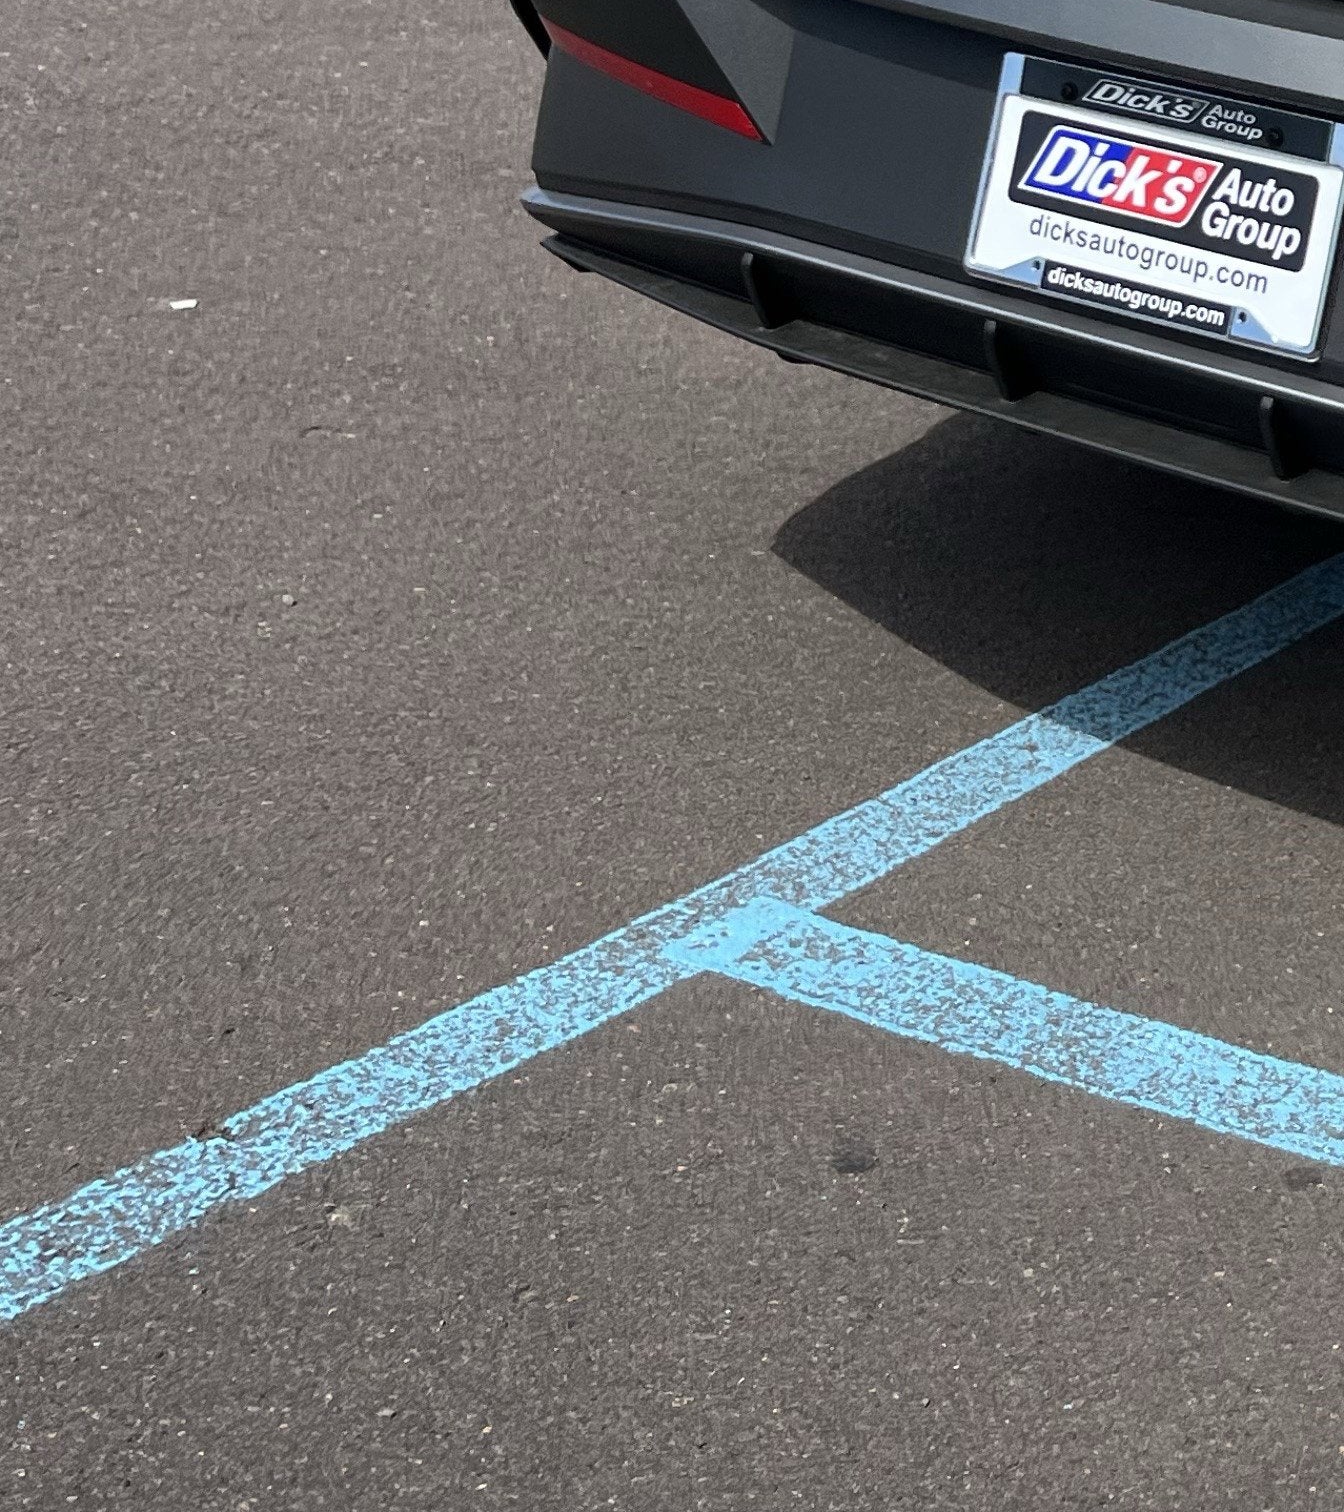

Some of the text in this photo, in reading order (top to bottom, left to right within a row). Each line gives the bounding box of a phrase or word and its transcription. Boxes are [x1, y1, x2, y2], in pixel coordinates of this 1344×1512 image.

[1092, 82, 1195, 119] Dick's
[1208, 104, 1257, 125] Auto
[1200, 114, 1264, 141] Group
[1211, 167, 1295, 217] Auto
[1029, 214, 1268, 294] dicksautogroup.com
[1200, 200, 1302, 260] Group
[1046, 266, 1226, 326] dicksautogroup.com
